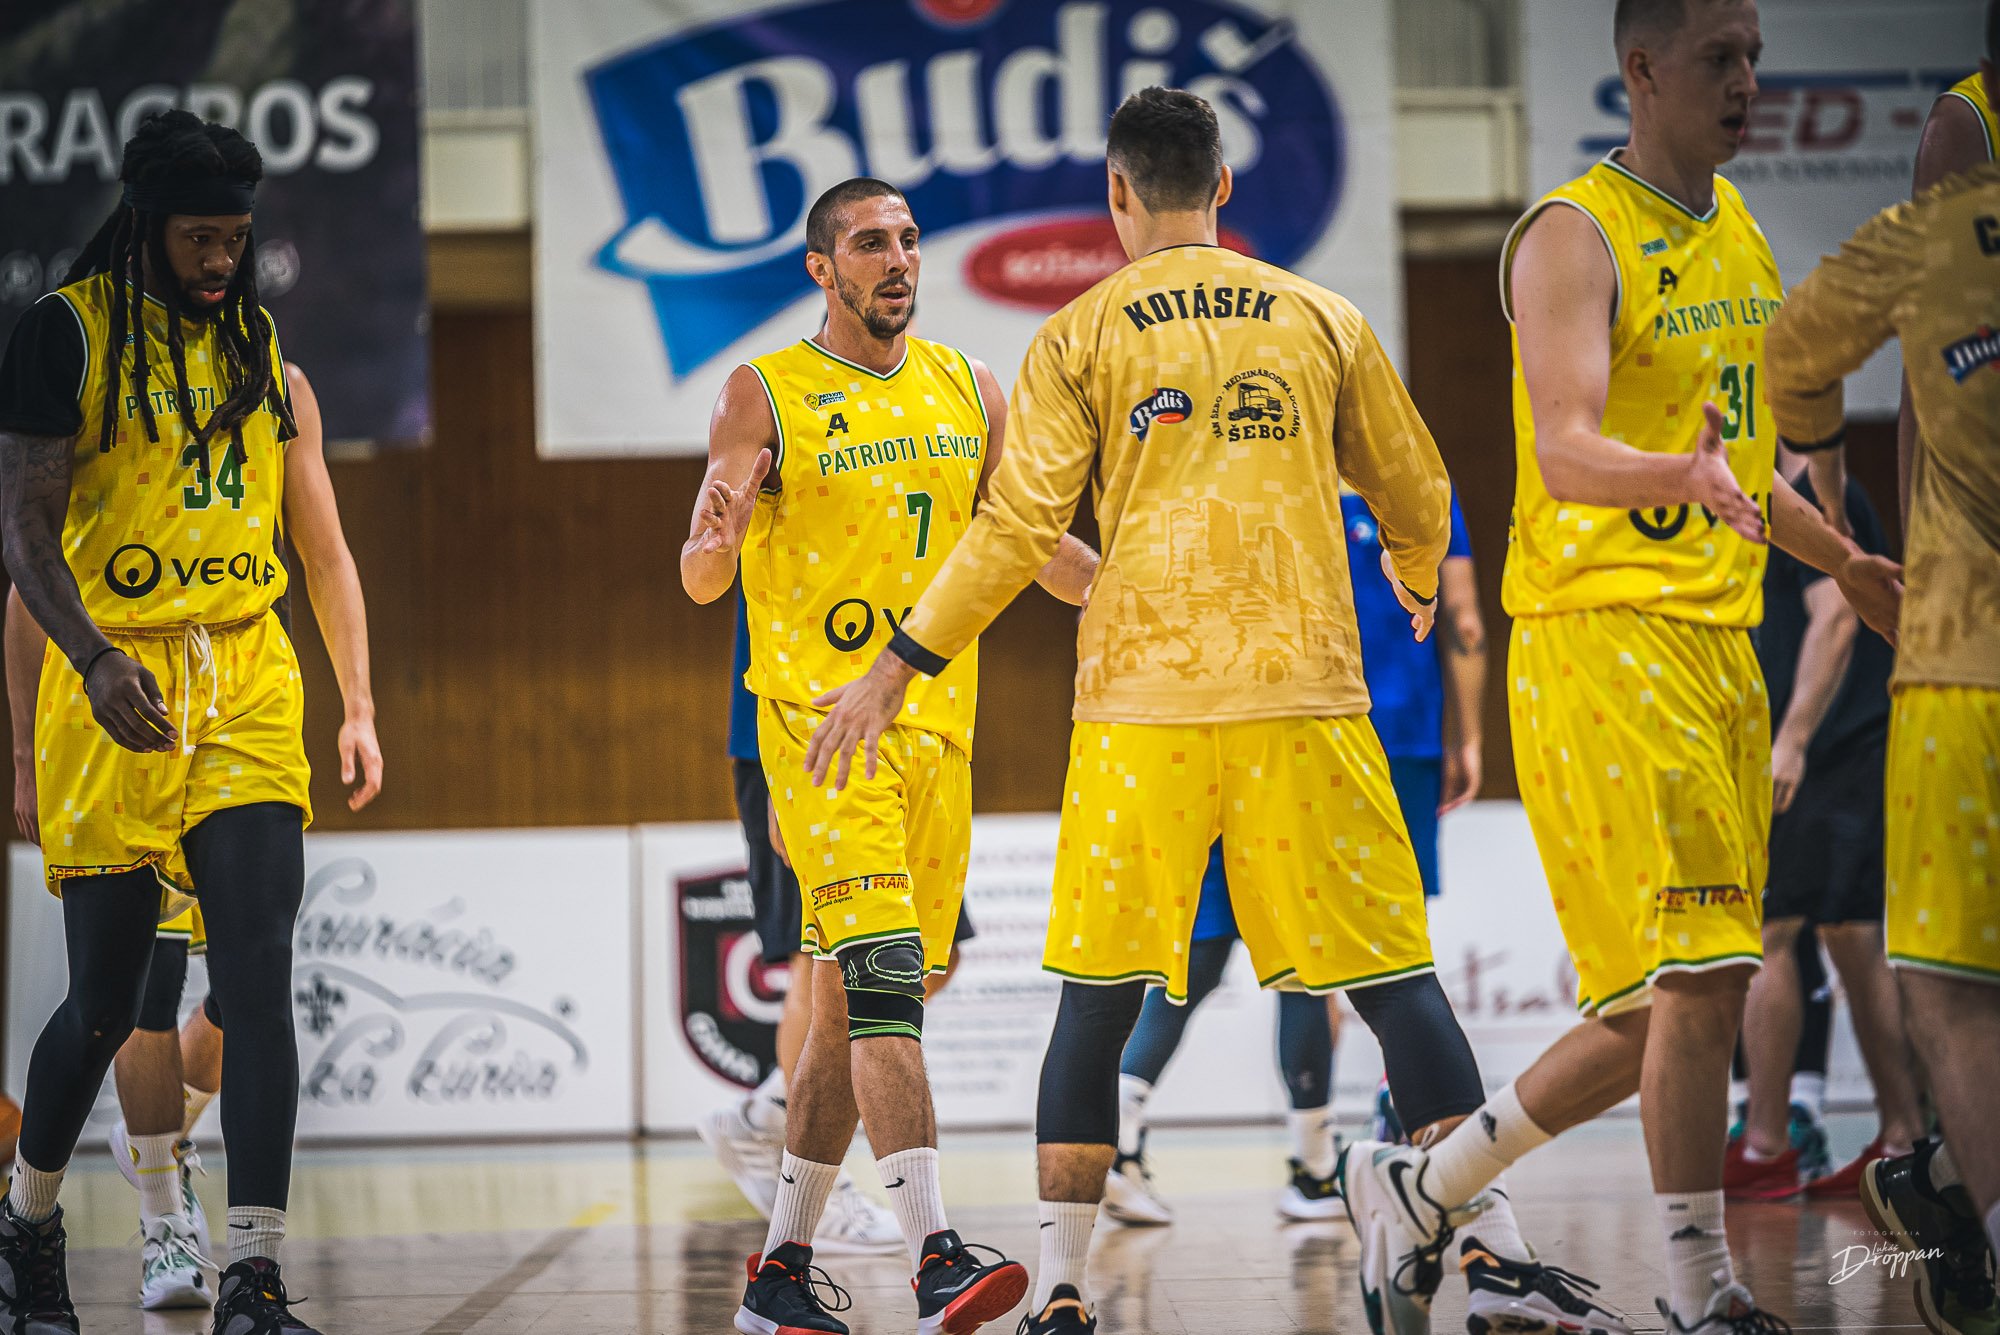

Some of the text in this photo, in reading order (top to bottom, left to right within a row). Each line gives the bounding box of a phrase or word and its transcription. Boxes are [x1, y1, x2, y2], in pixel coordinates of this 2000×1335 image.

[1123, 283, 1277, 332] KOTÁSEK
[1719, 362, 1756, 440] 31
[817, 434, 981, 476] PATRIOTI LEVICE
[1228, 424, 1286, 442] ŠEBO
[182, 443, 246, 511] 34
[905, 491, 933, 560] 7
[811, 882, 850, 906] SPED
